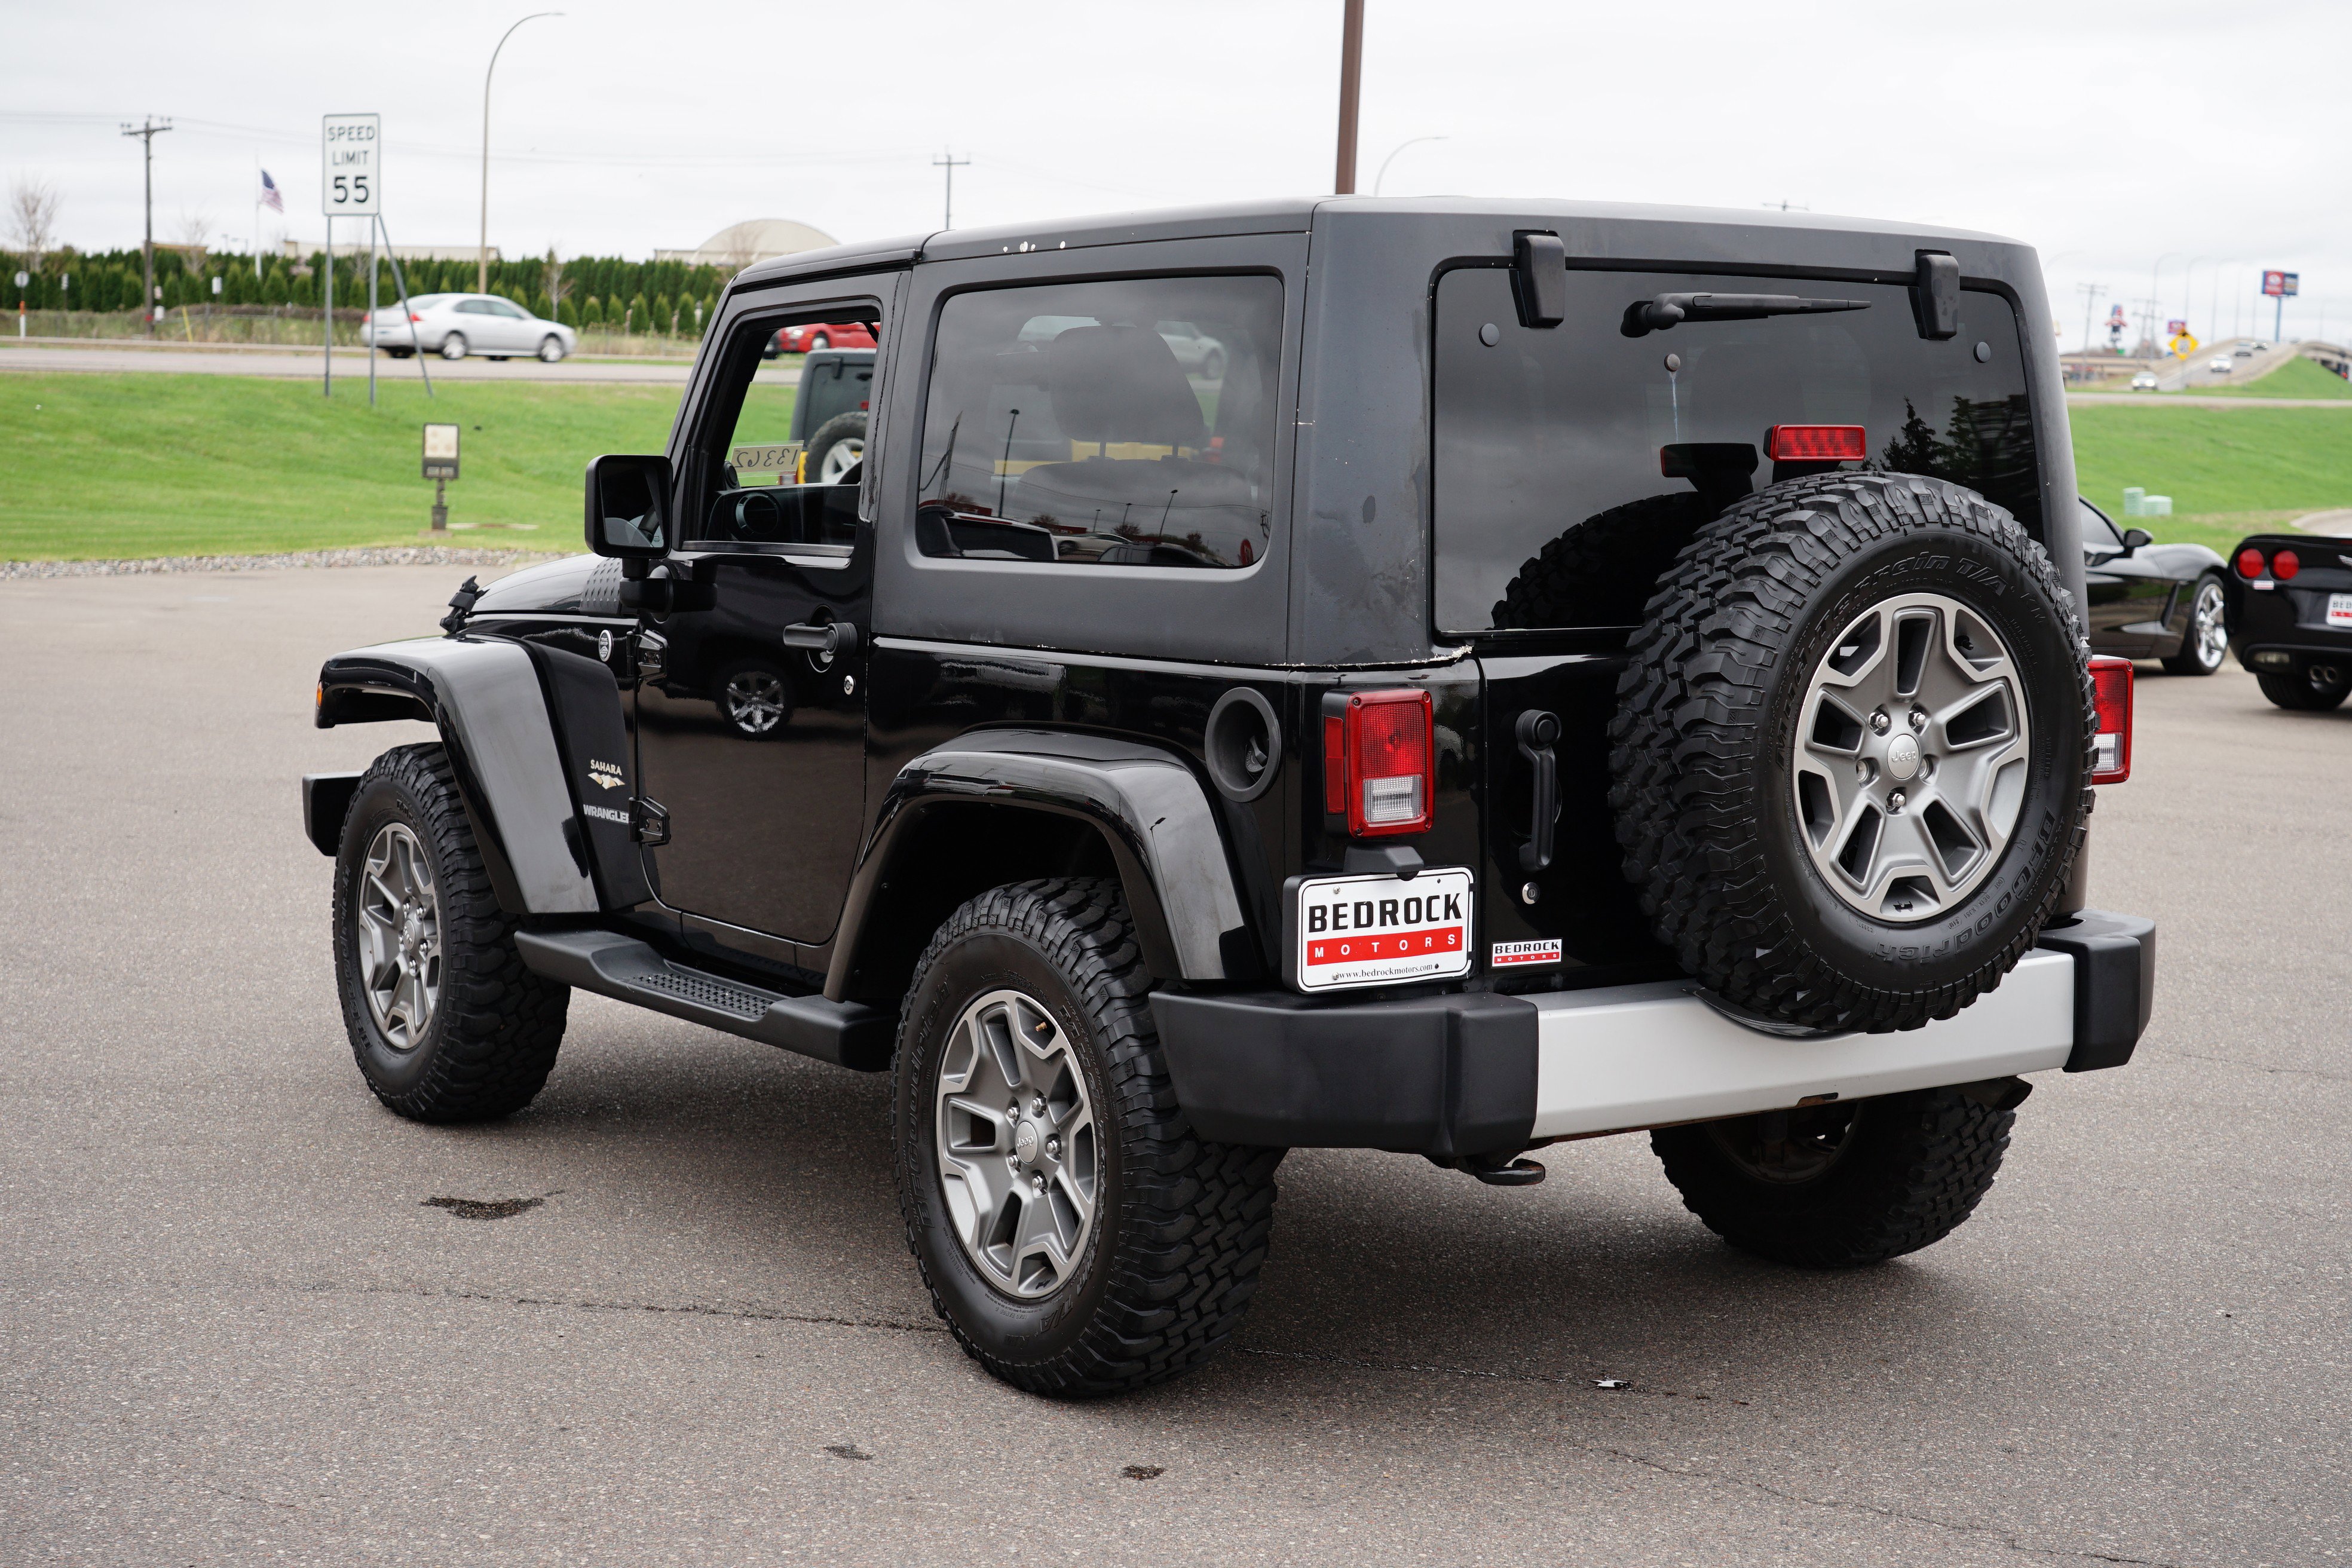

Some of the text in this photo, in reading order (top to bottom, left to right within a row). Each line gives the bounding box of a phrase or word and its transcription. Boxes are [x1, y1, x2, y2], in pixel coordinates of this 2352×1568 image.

[328, 126, 375, 141] SPEED
[332, 150, 369, 166] LIMIT
[334, 176, 369, 203] 55
[1891, 751, 1916, 762] Jeep
[590, 760, 622, 776] SAHARA
[1308, 893, 1462, 933] BEDROCK
[1315, 933, 1456, 958] MOTORS
[1495, 941, 1559, 954] BEDROCK
[1497, 953, 1557, 962] MOTORS
[1339, 963, 1433, 979] www.bedrockmotors.com
[1017, 1135, 1034, 1149] Jeep
